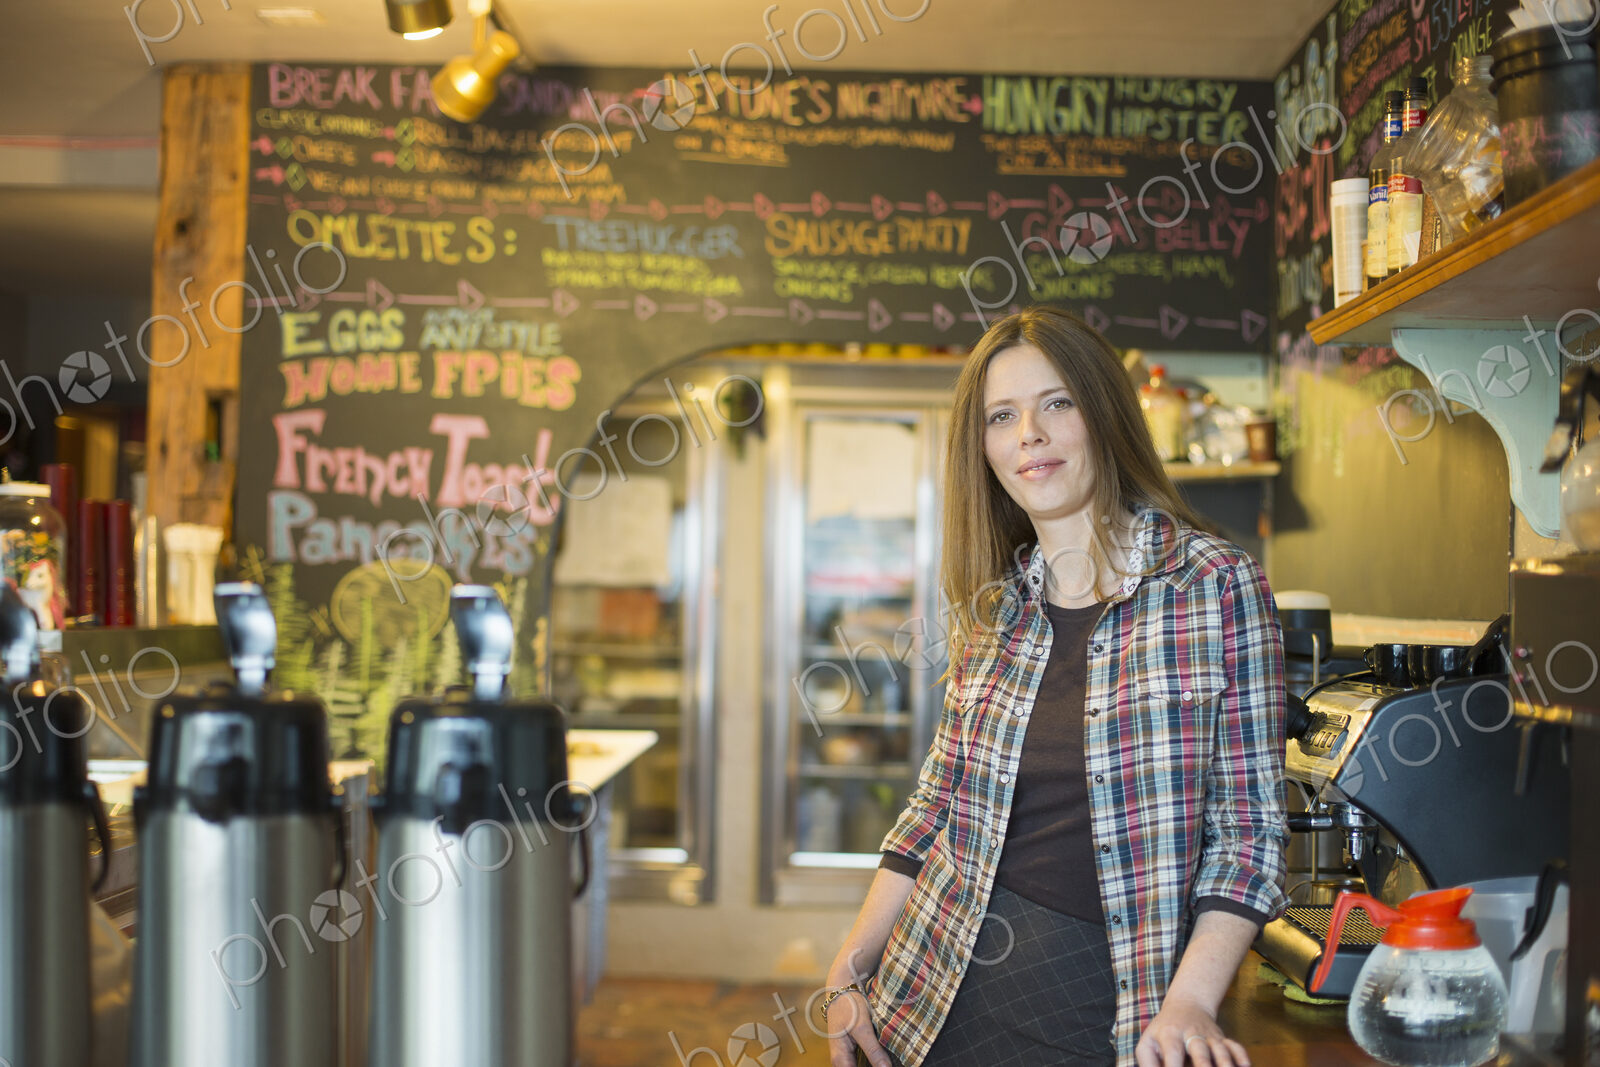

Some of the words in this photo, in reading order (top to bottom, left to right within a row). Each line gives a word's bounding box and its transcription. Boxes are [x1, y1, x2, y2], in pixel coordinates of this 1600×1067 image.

[268, 63, 382, 110] BREAK
[981, 74, 1111, 135] HUNGRY
[1113, 75, 1239, 113] HUNGRY
[1111, 105, 1250, 144] HIPSTER
[763, 212, 896, 258] SAUSAGE
[281, 308, 405, 358] EGGS
